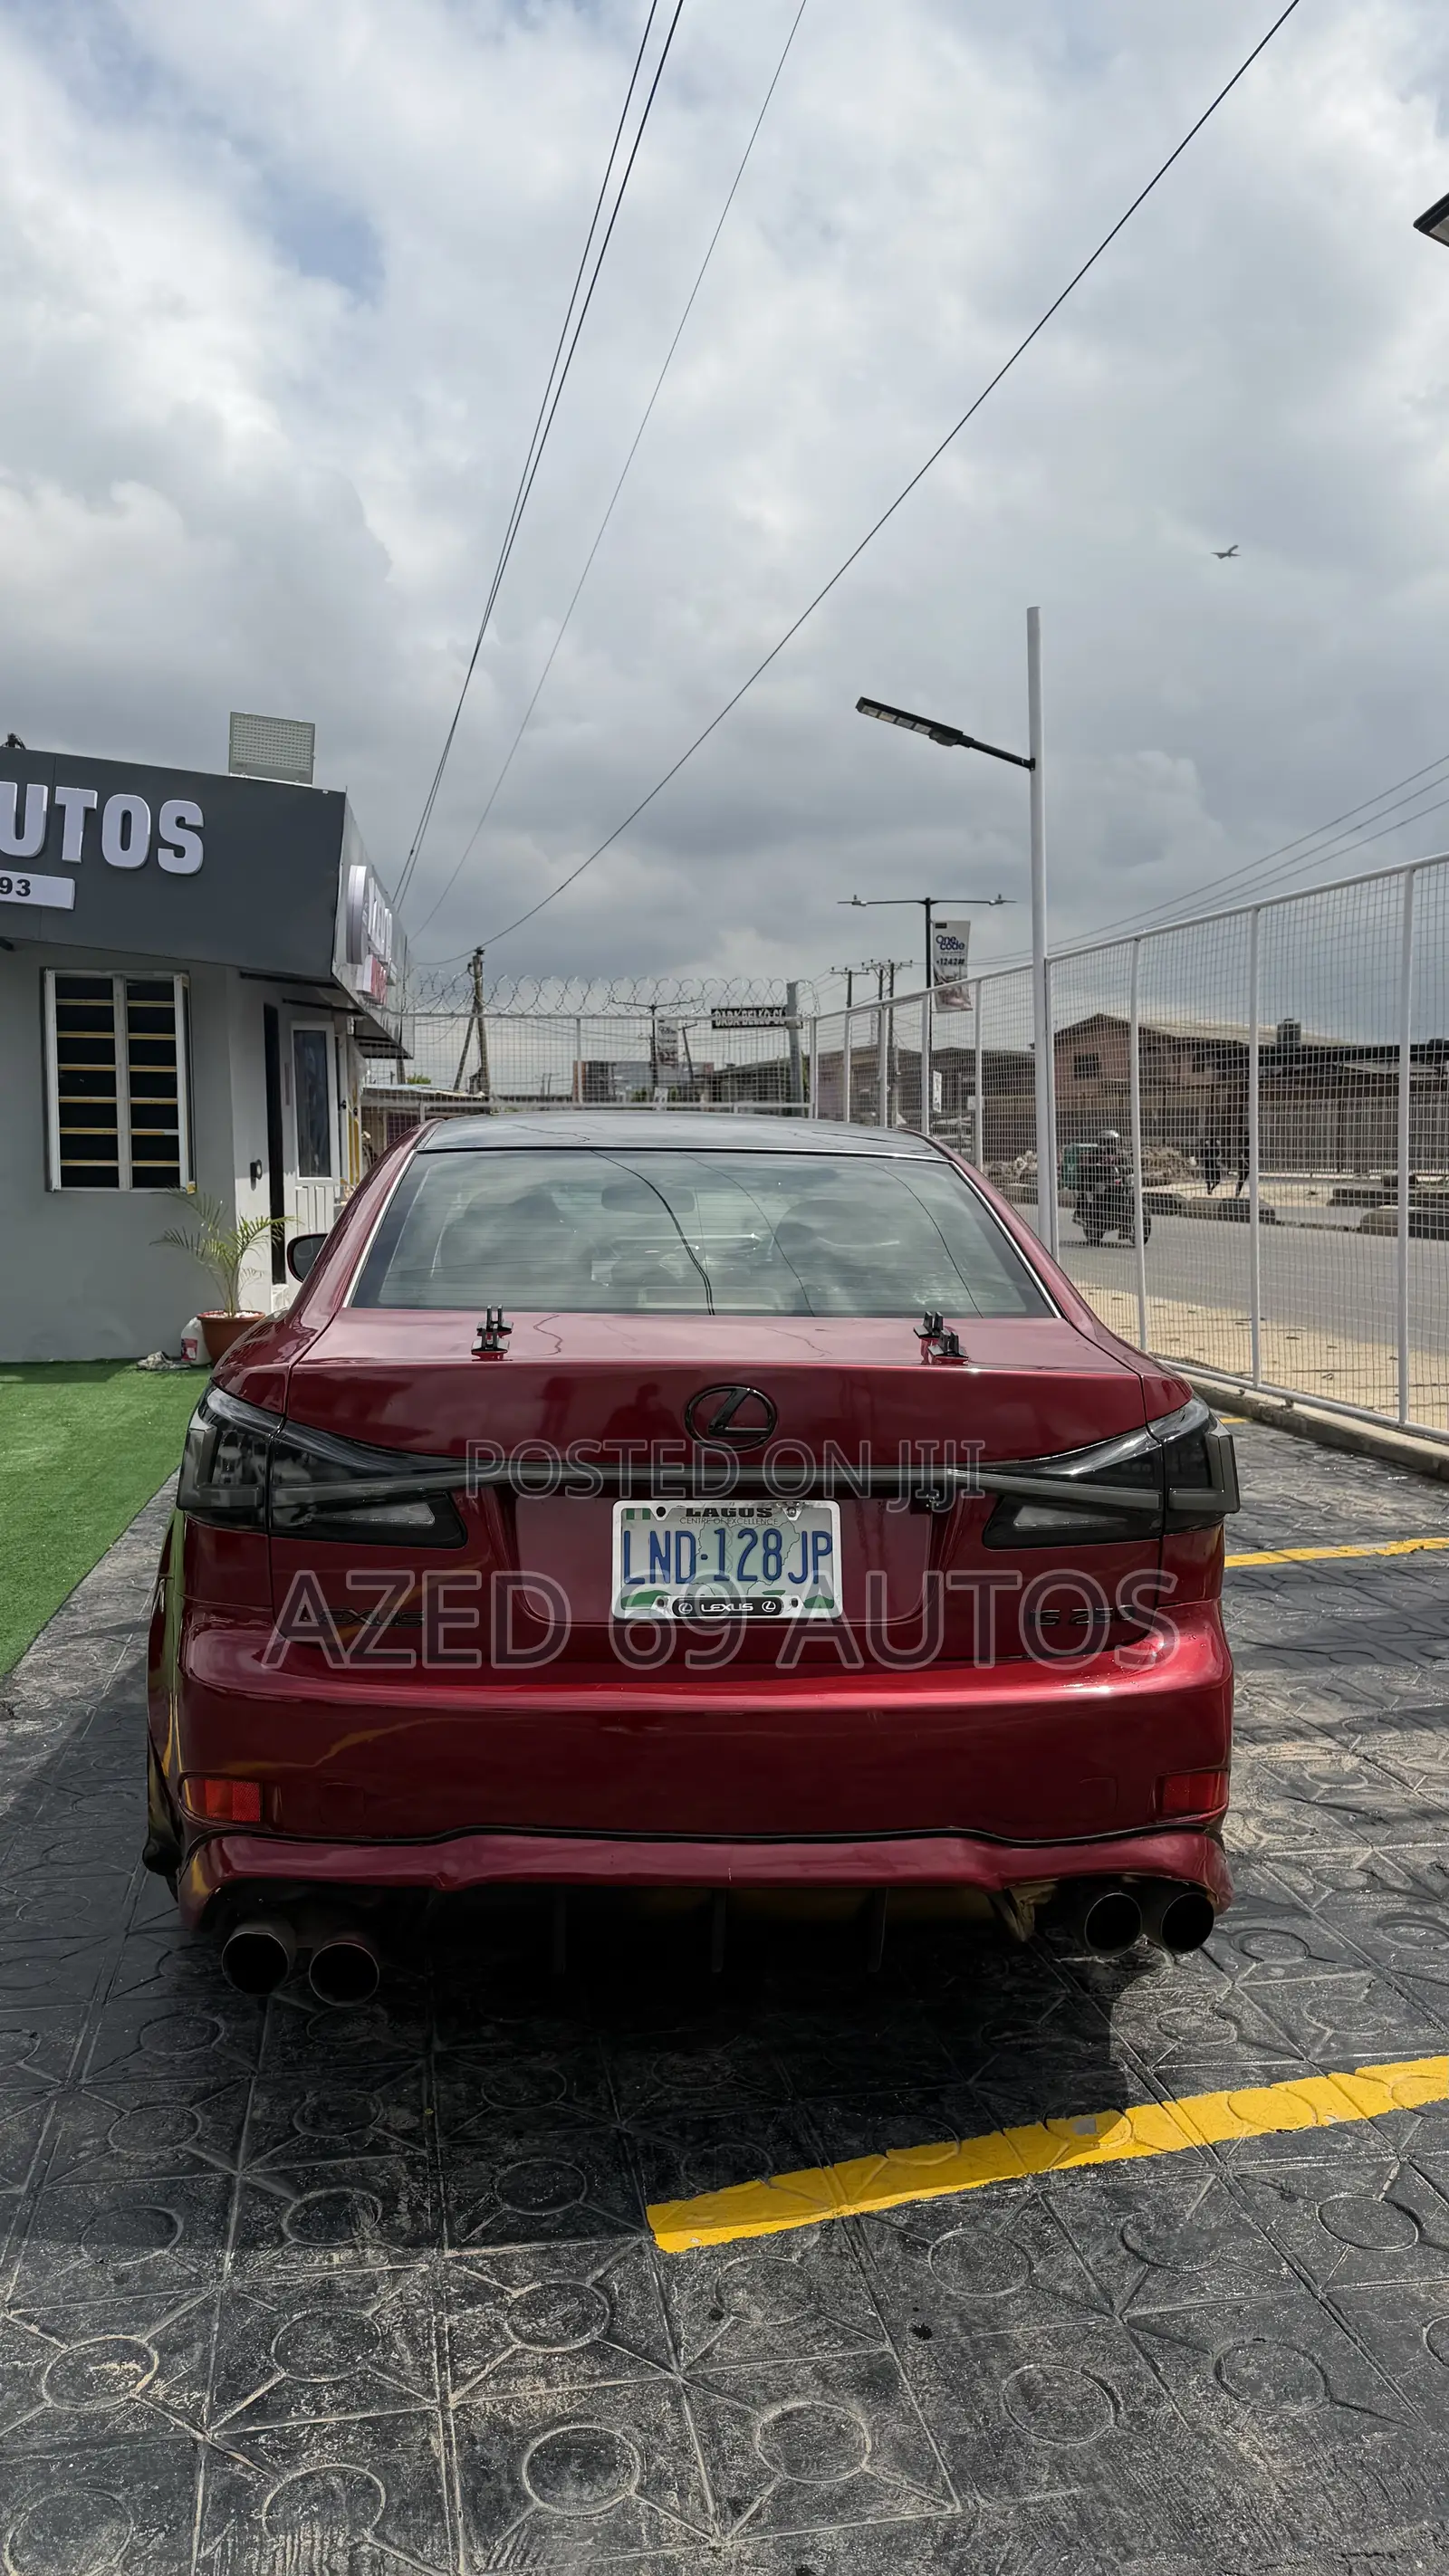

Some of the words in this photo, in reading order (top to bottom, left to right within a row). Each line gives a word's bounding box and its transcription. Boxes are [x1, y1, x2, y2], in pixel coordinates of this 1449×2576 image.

[936, 934, 956, 944] One
[939, 940, 965, 950] code
[686, 1508, 772, 1518] LAGOS
[726, 1518, 778, 1526] EXCELLENCE
[701, 1603, 753, 1613] LEXUS
